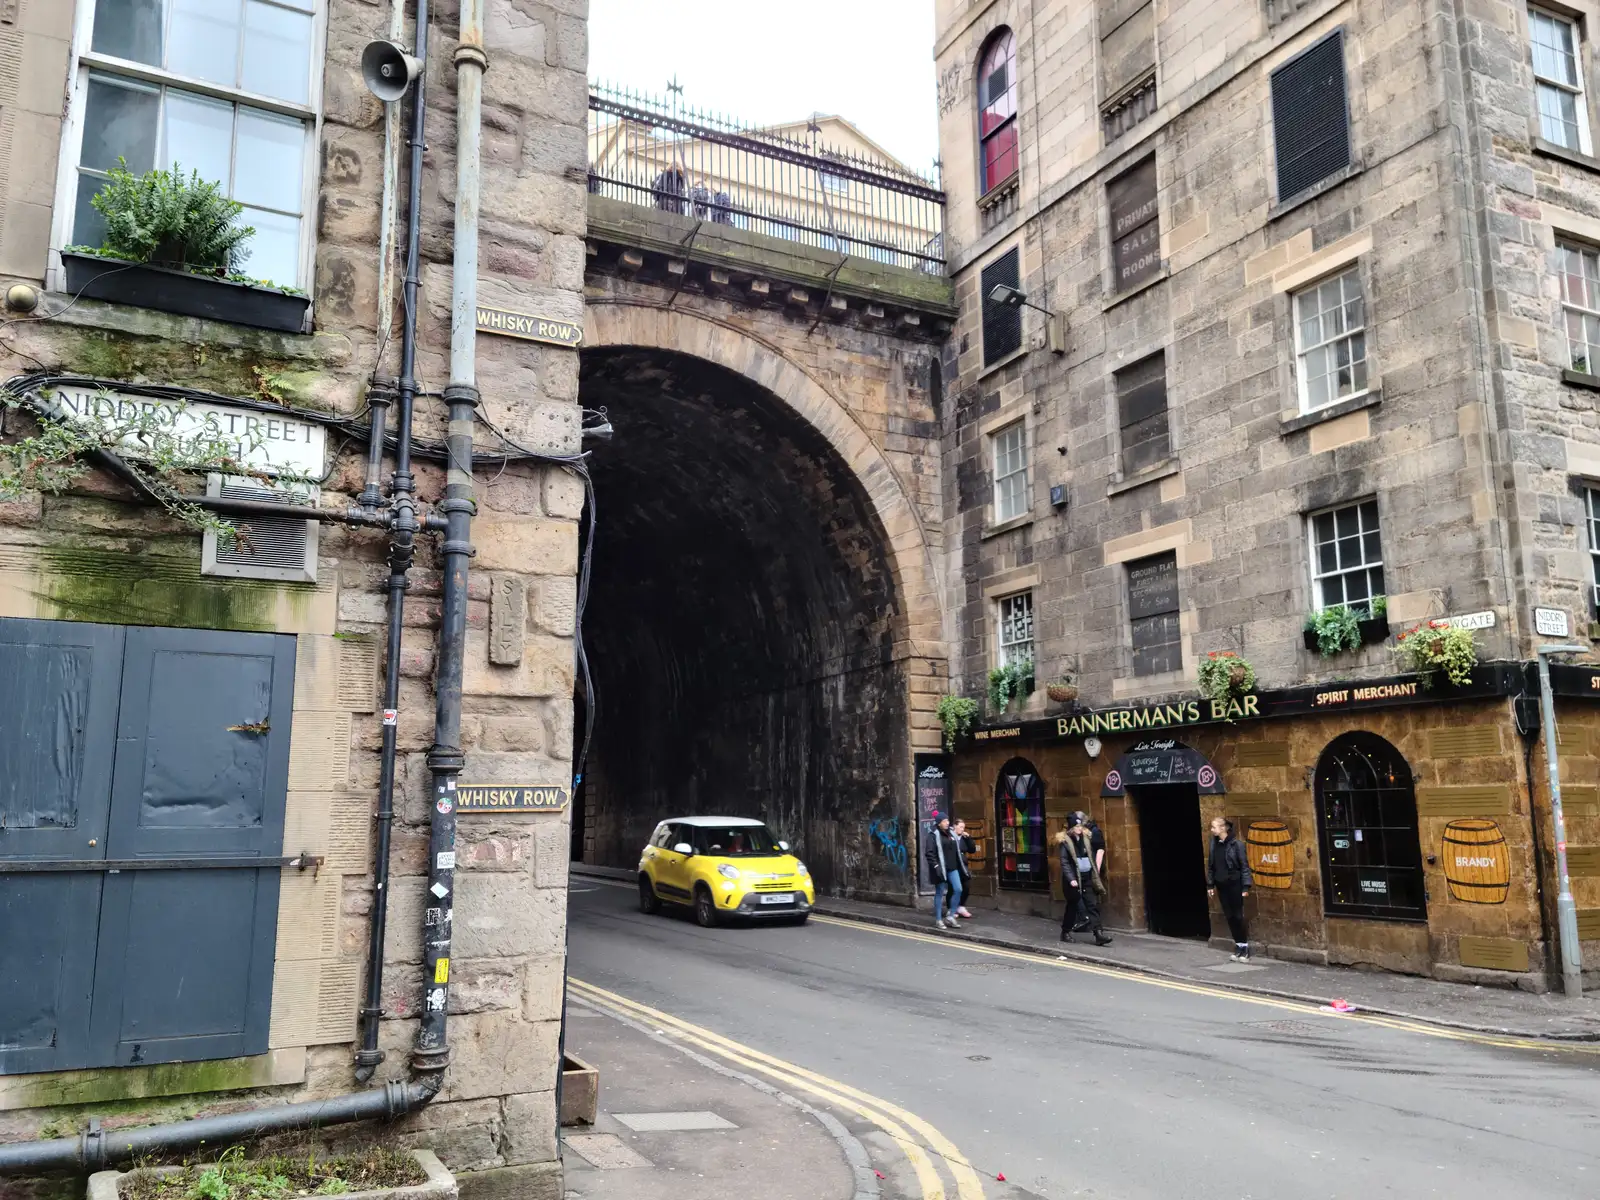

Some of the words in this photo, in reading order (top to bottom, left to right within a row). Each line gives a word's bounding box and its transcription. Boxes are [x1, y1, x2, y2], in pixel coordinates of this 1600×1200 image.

[1122, 227, 1157, 255] SALE
[1122, 249, 1160, 279] ROOMS
[476, 310, 534, 334] WHISKY
[538, 321, 571, 340] ROW
[205, 410, 318, 445] STREET
[1130, 566, 1157, 579] GROUND
[1159, 561, 1175, 572] FLAT
[1538, 611, 1563, 622] NIDDRY
[1539, 622, 1565, 634] STREET
[1316, 690, 1349, 705] SPIRIT
[1353, 682, 1417, 701] MERCHANT
[1057, 701, 1200, 736] BANNERMAN'S
[1211, 694, 1261, 719] BAR
[974, 731, 989, 740] WINE
[990, 727, 1020, 738] MERCHANT
[1150, 739, 1175, 751] Tonight
[457, 789, 518, 806] WHISKY
[523, 789, 559, 806] ROW
[1261, 854, 1279, 863] ALE
[1455, 856, 1496, 868] BRANDY
